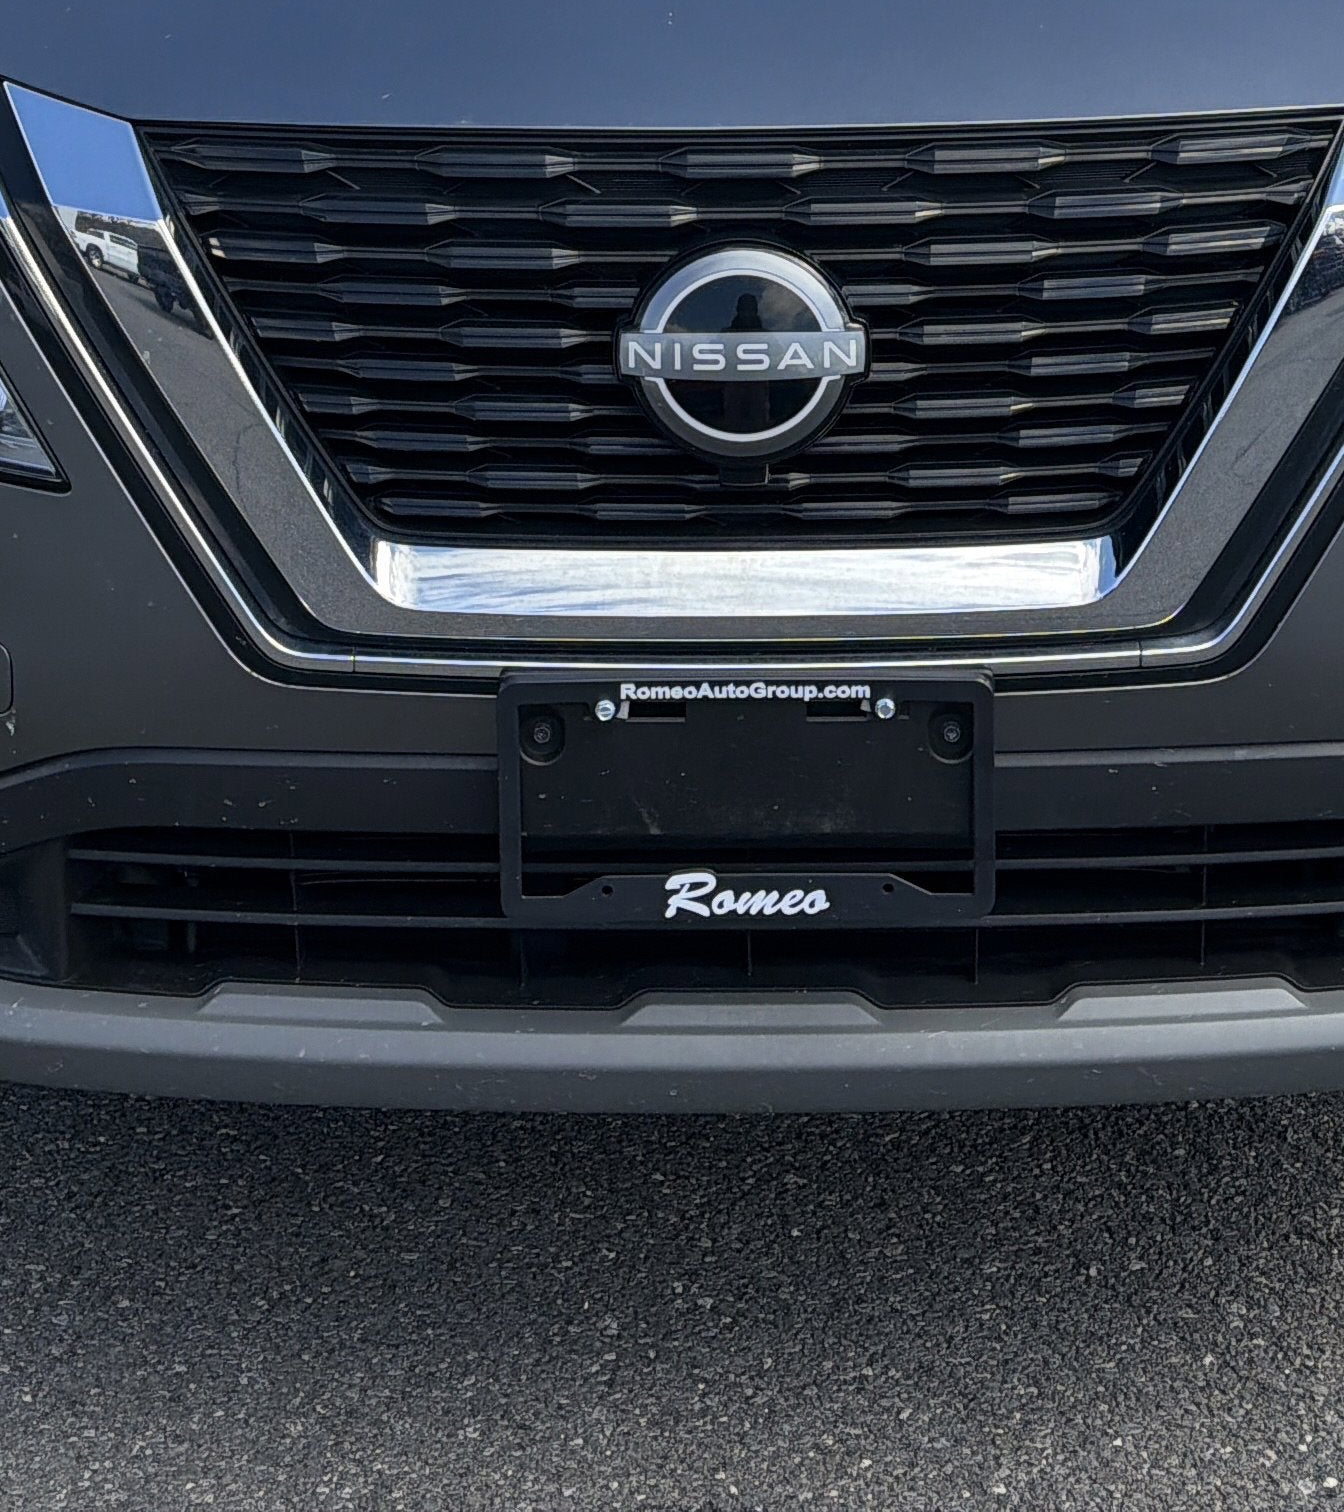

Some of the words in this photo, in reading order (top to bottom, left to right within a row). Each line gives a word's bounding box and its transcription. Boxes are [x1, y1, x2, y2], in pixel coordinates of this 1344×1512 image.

[627, 339, 858, 371] NISSAN
[620, 682, 871, 702] RomeoAutoGroup.com
[664, 872, 831, 919] Romeo
